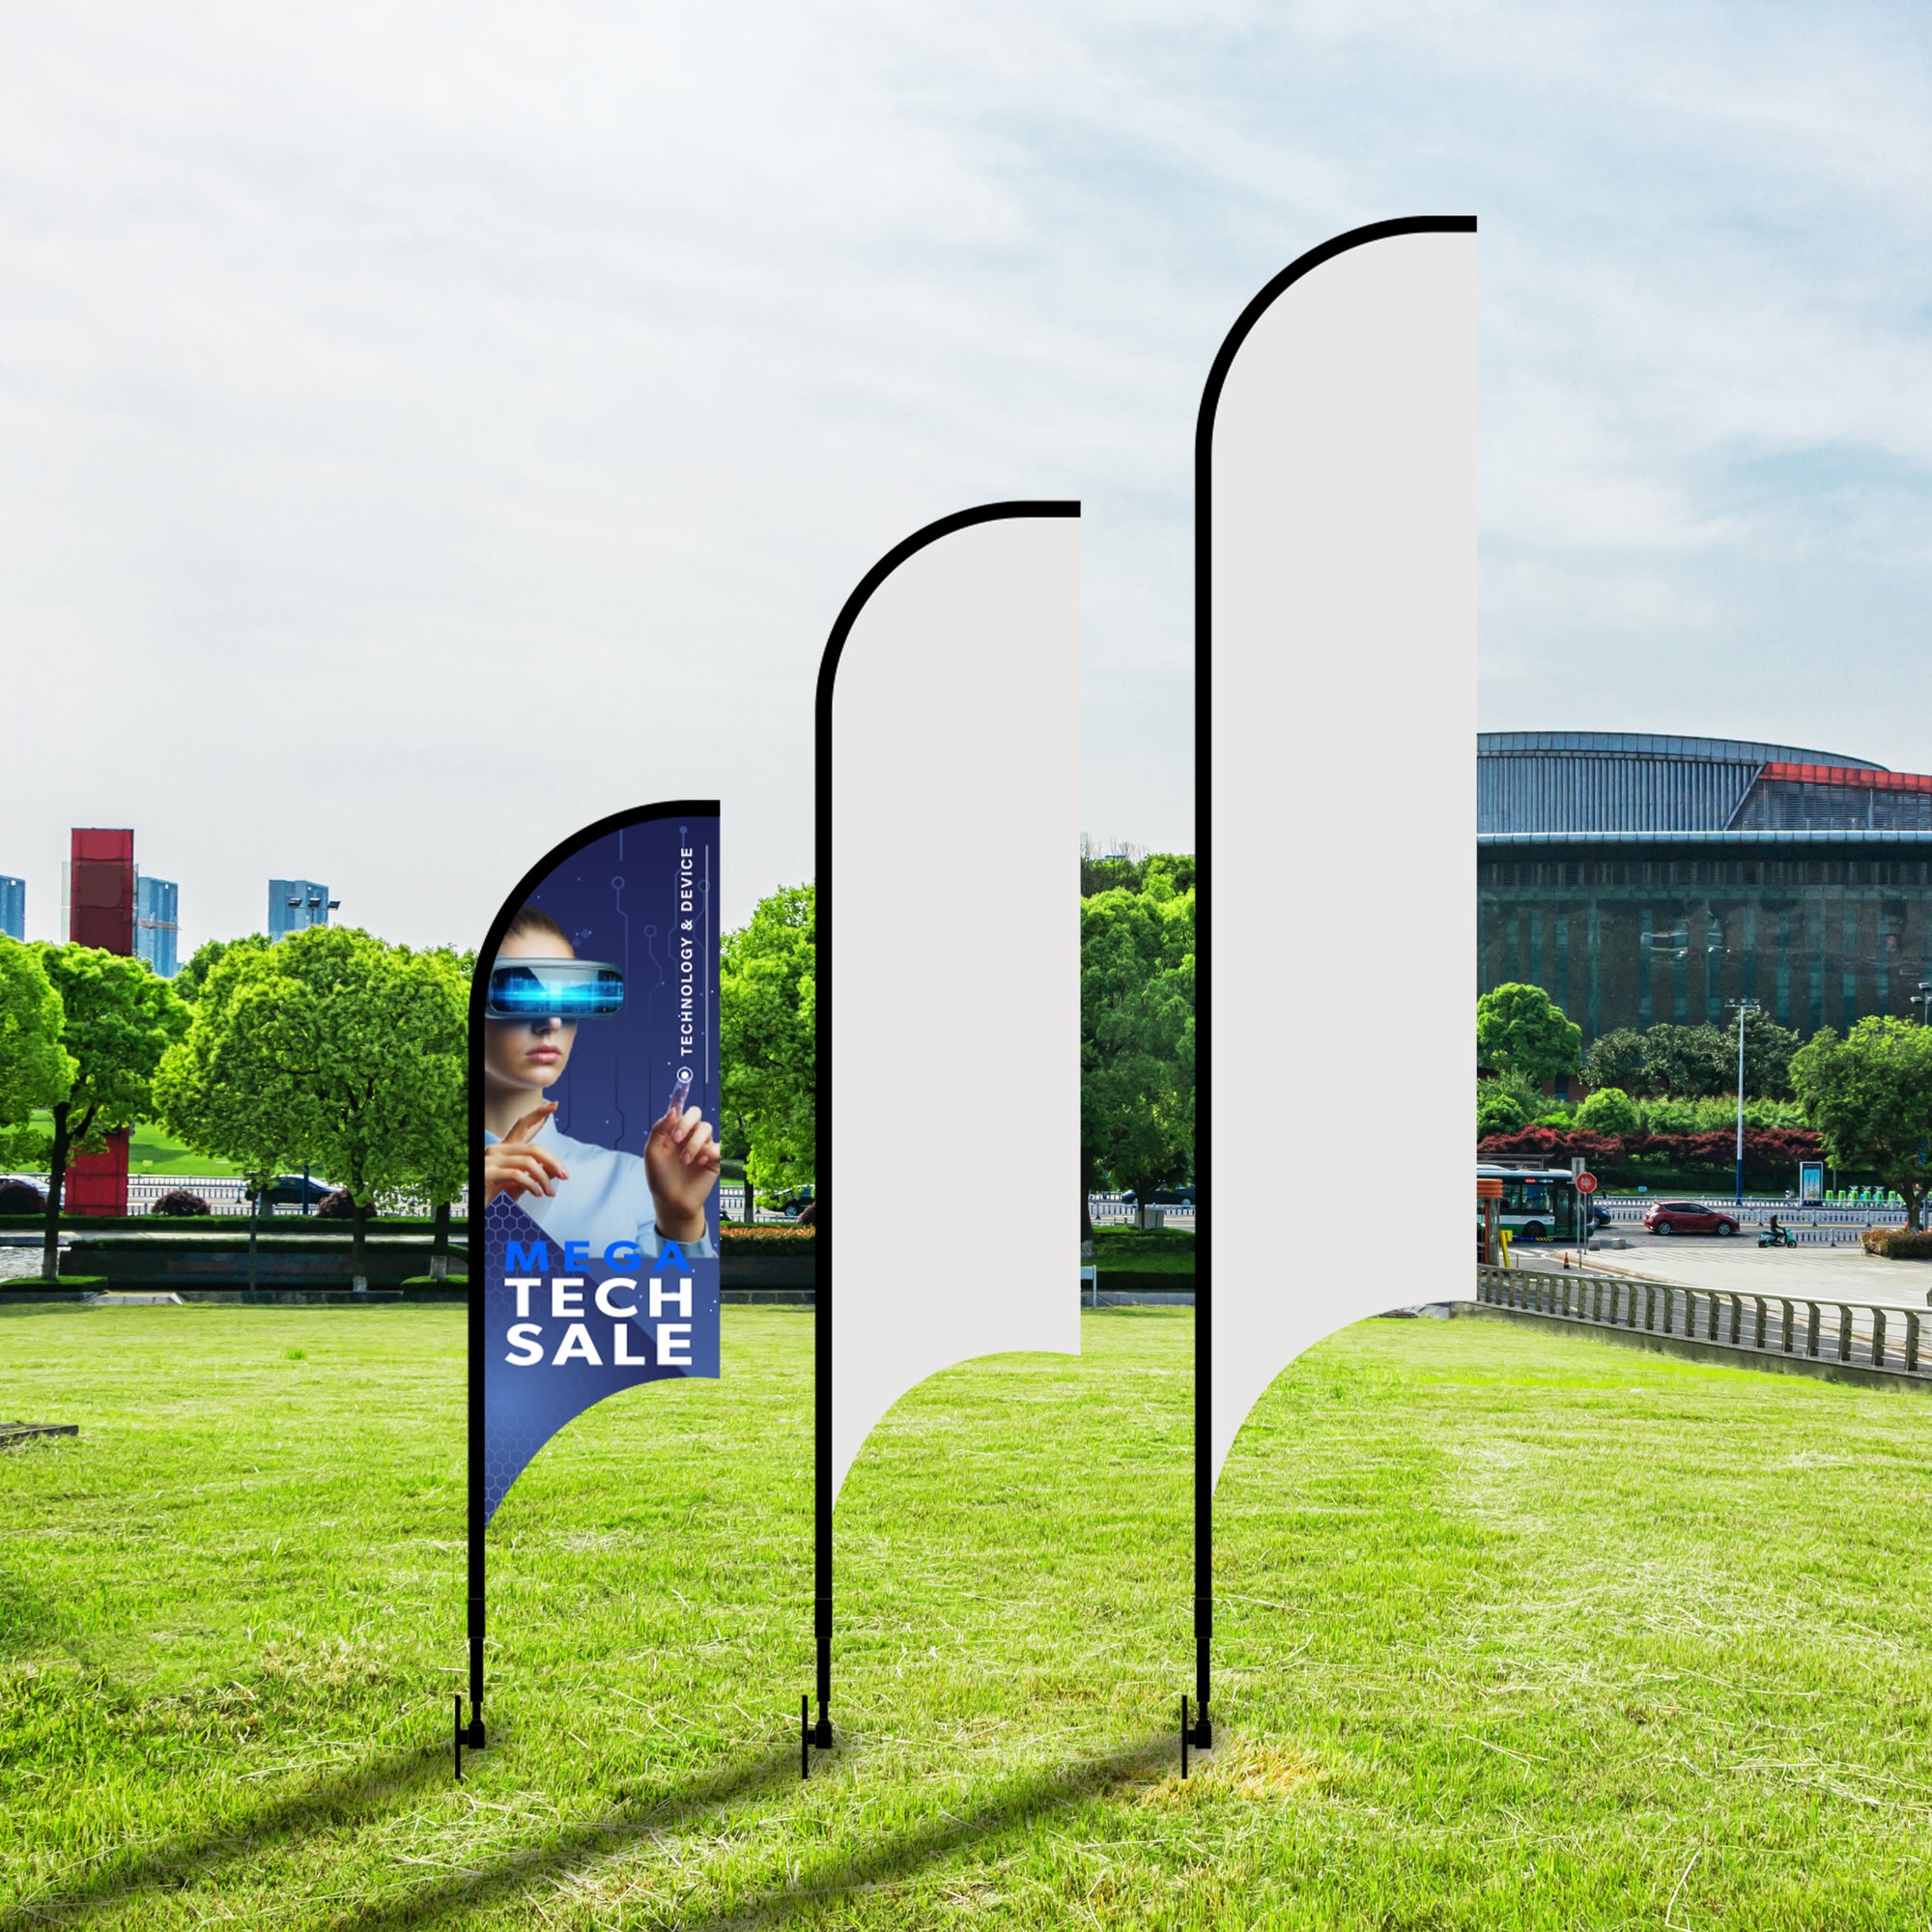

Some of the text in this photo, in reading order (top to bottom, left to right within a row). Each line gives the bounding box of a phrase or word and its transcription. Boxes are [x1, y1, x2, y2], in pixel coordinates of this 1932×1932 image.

[680, 847, 694, 1057] TECHNOLOGY & DEVICE
[504, 1240, 692, 1272] MEGA
[504, 1277, 694, 1318] TECH
[504, 1322, 694, 1367] SALE
